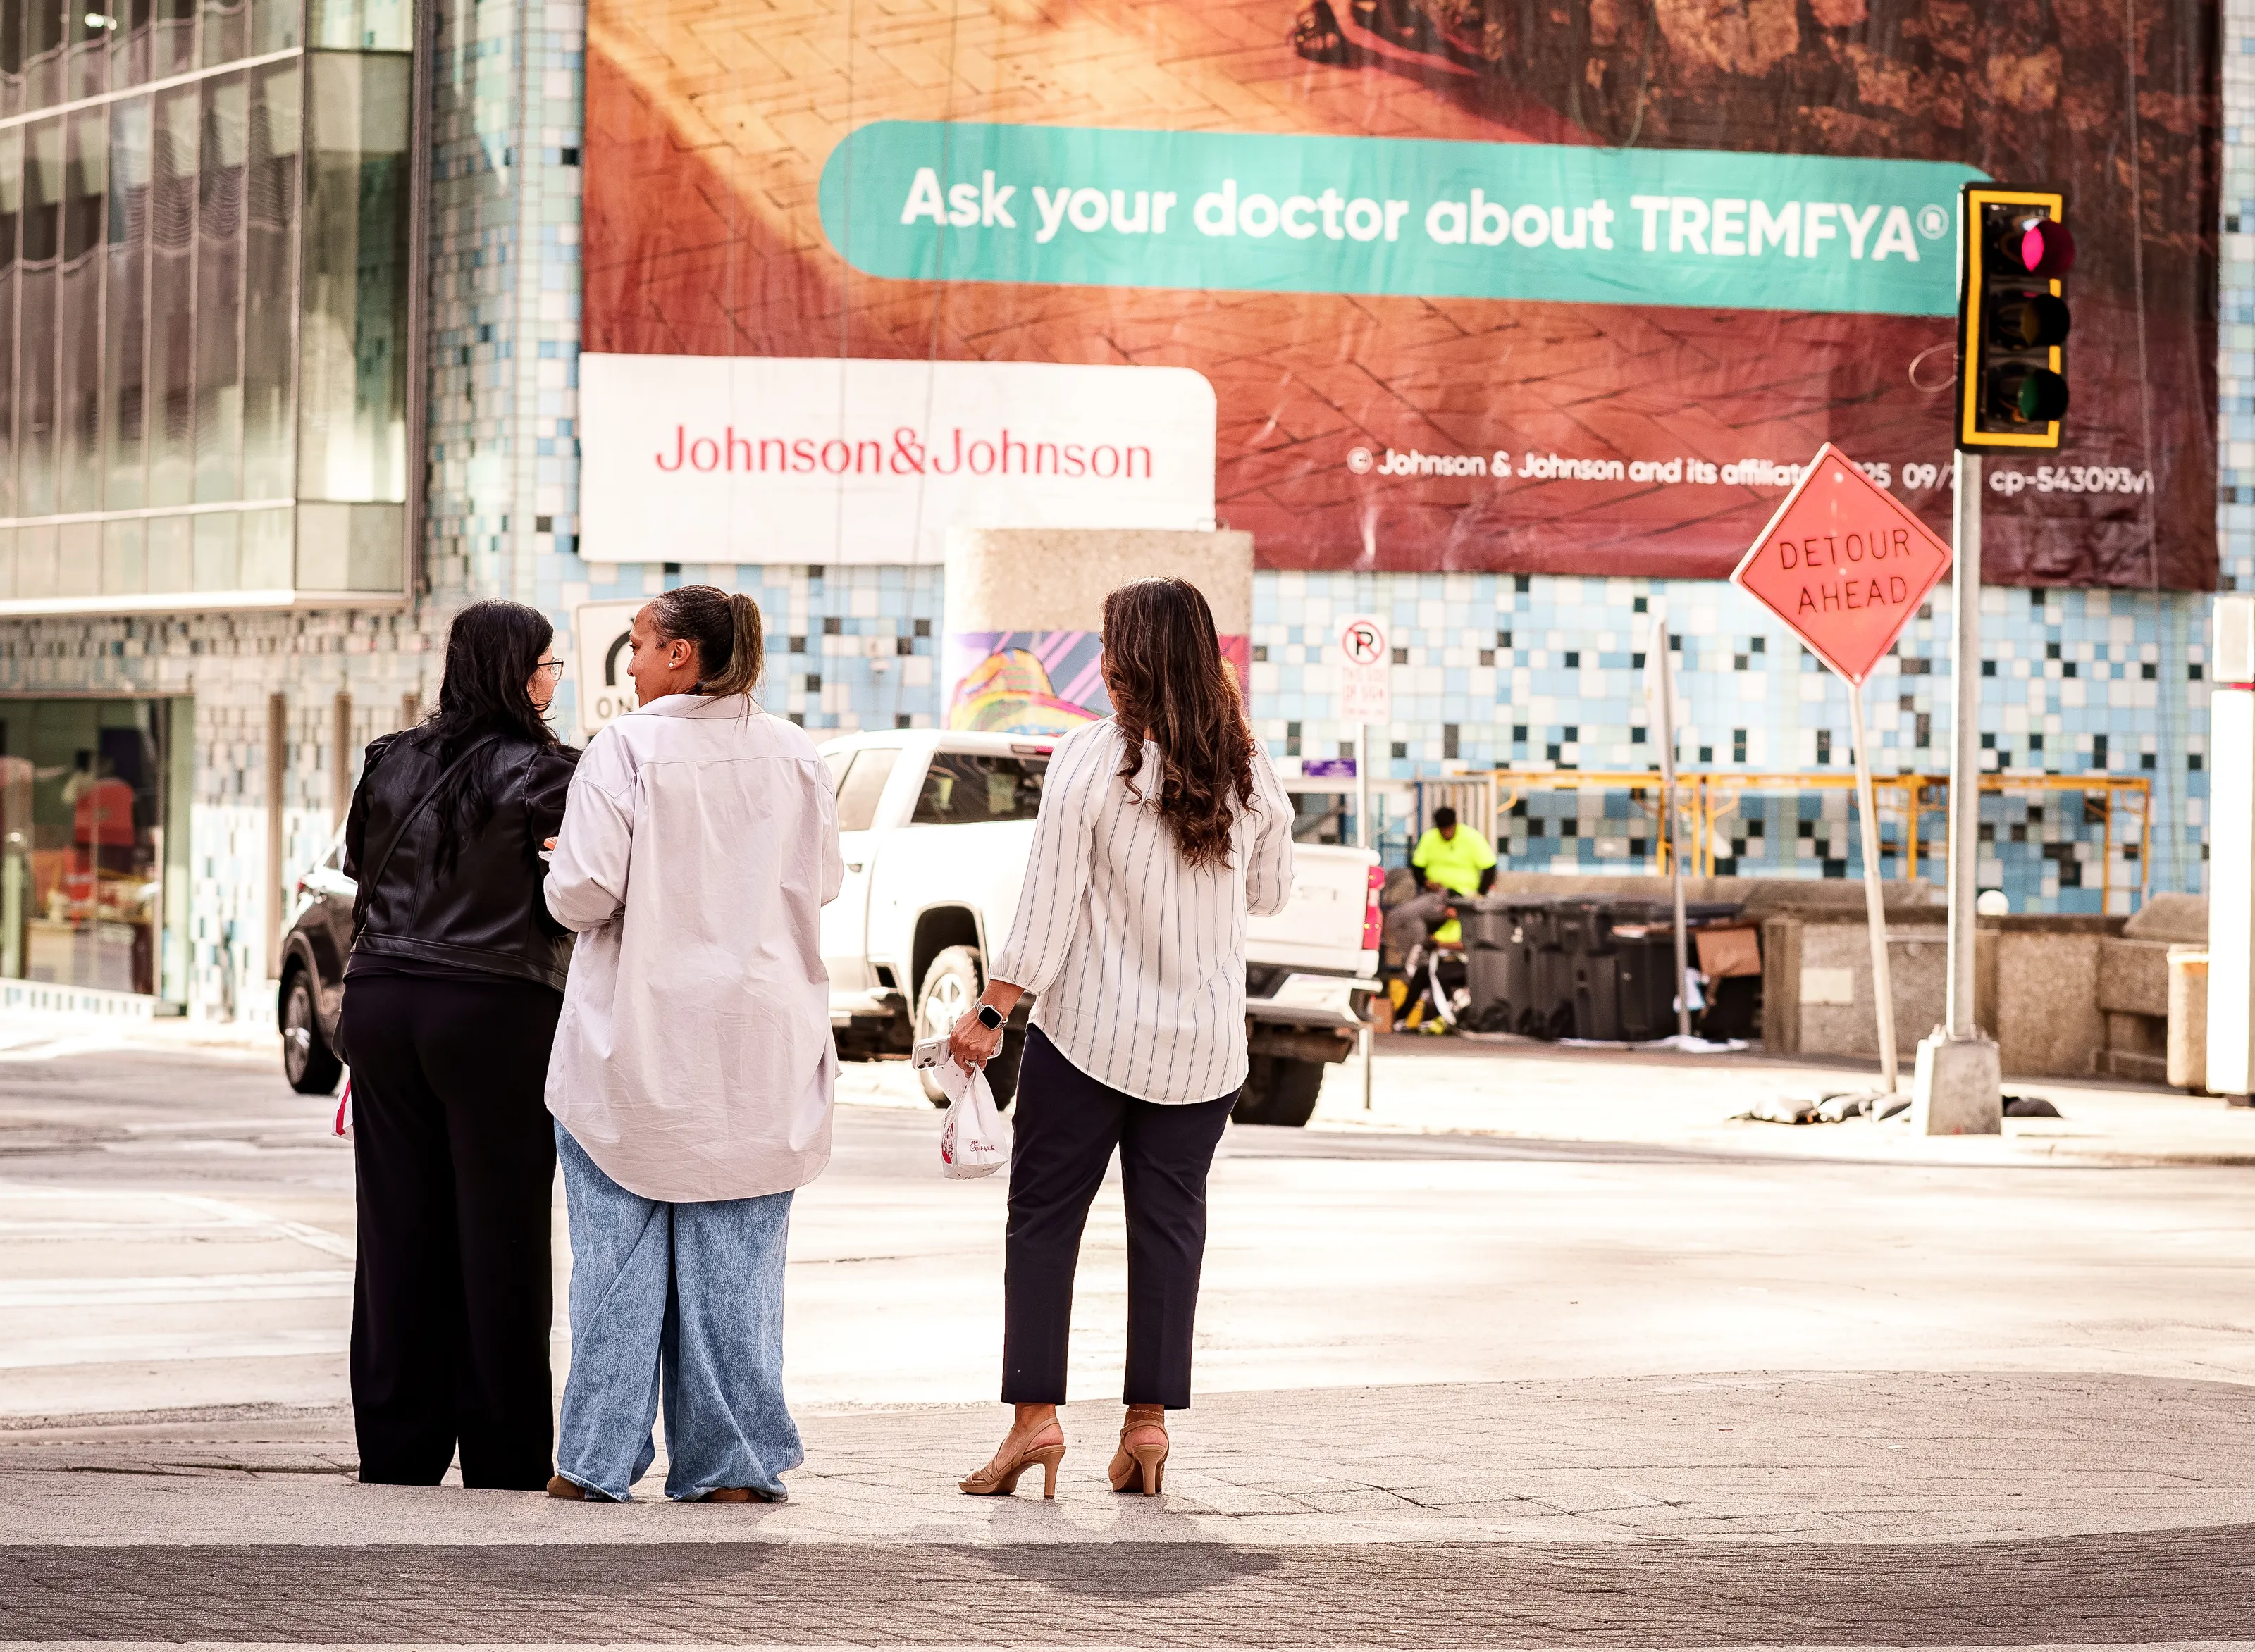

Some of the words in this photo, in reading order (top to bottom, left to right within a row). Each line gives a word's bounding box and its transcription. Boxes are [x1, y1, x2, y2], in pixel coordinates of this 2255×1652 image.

[901, 167, 1017, 229] Ask
[1032, 185, 1177, 244] your
[1193, 178, 1409, 242] doctor
[1424, 187, 1615, 251] about
[1629, 194, 1950, 263] TREMFYA®
[656, 424, 1152, 478] Johnson&Johnson
[1376, 447, 1487, 477] Johnson
[1490, 450, 1512, 478] &
[1516, 451, 1625, 481] Johnson
[1628, 457, 1683, 484] and
[1686, 457, 1718, 485] its
[1852, 461, 1892, 490] 25
[1779, 528, 1910, 570] DETOUR
[1798, 576, 1908, 615] AHEAD
[596, 697, 634, 719] ON
